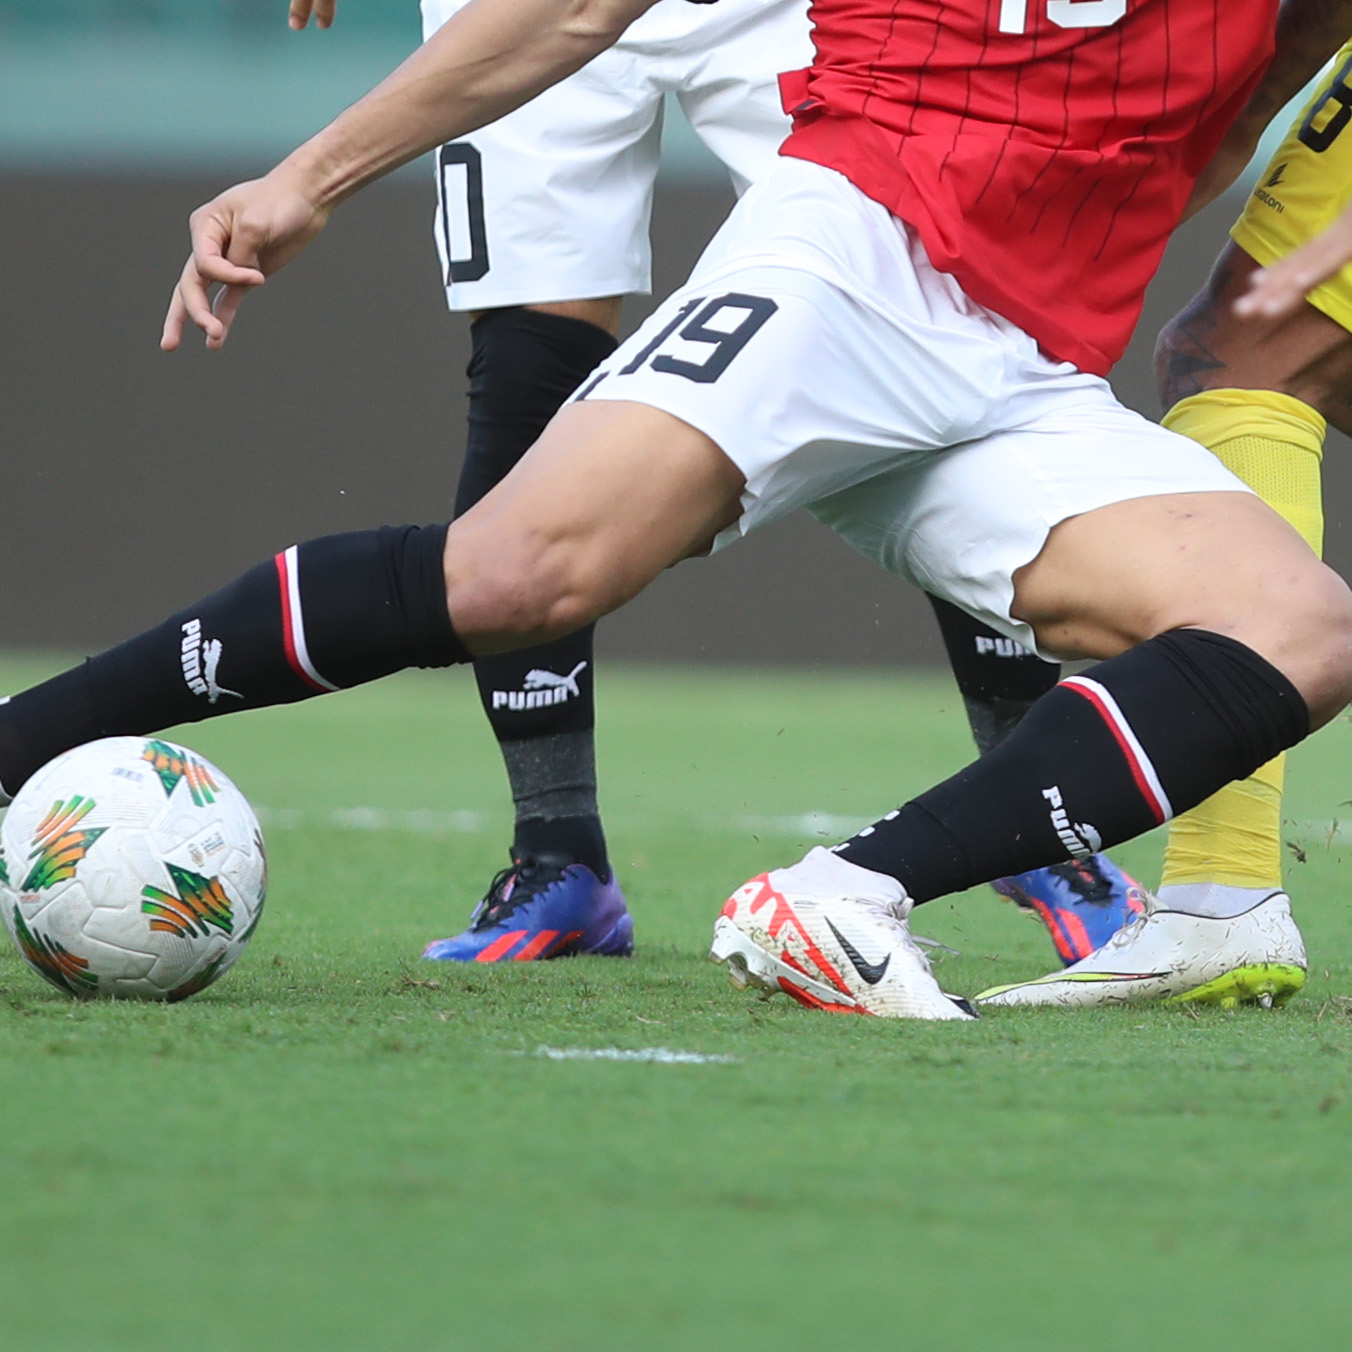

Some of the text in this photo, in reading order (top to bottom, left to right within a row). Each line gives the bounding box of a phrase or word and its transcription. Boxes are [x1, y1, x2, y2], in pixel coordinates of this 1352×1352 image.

[616, 291, 780, 384] 19
[180, 617, 208, 696] PUMA
[492, 684, 569, 711] PUMA
